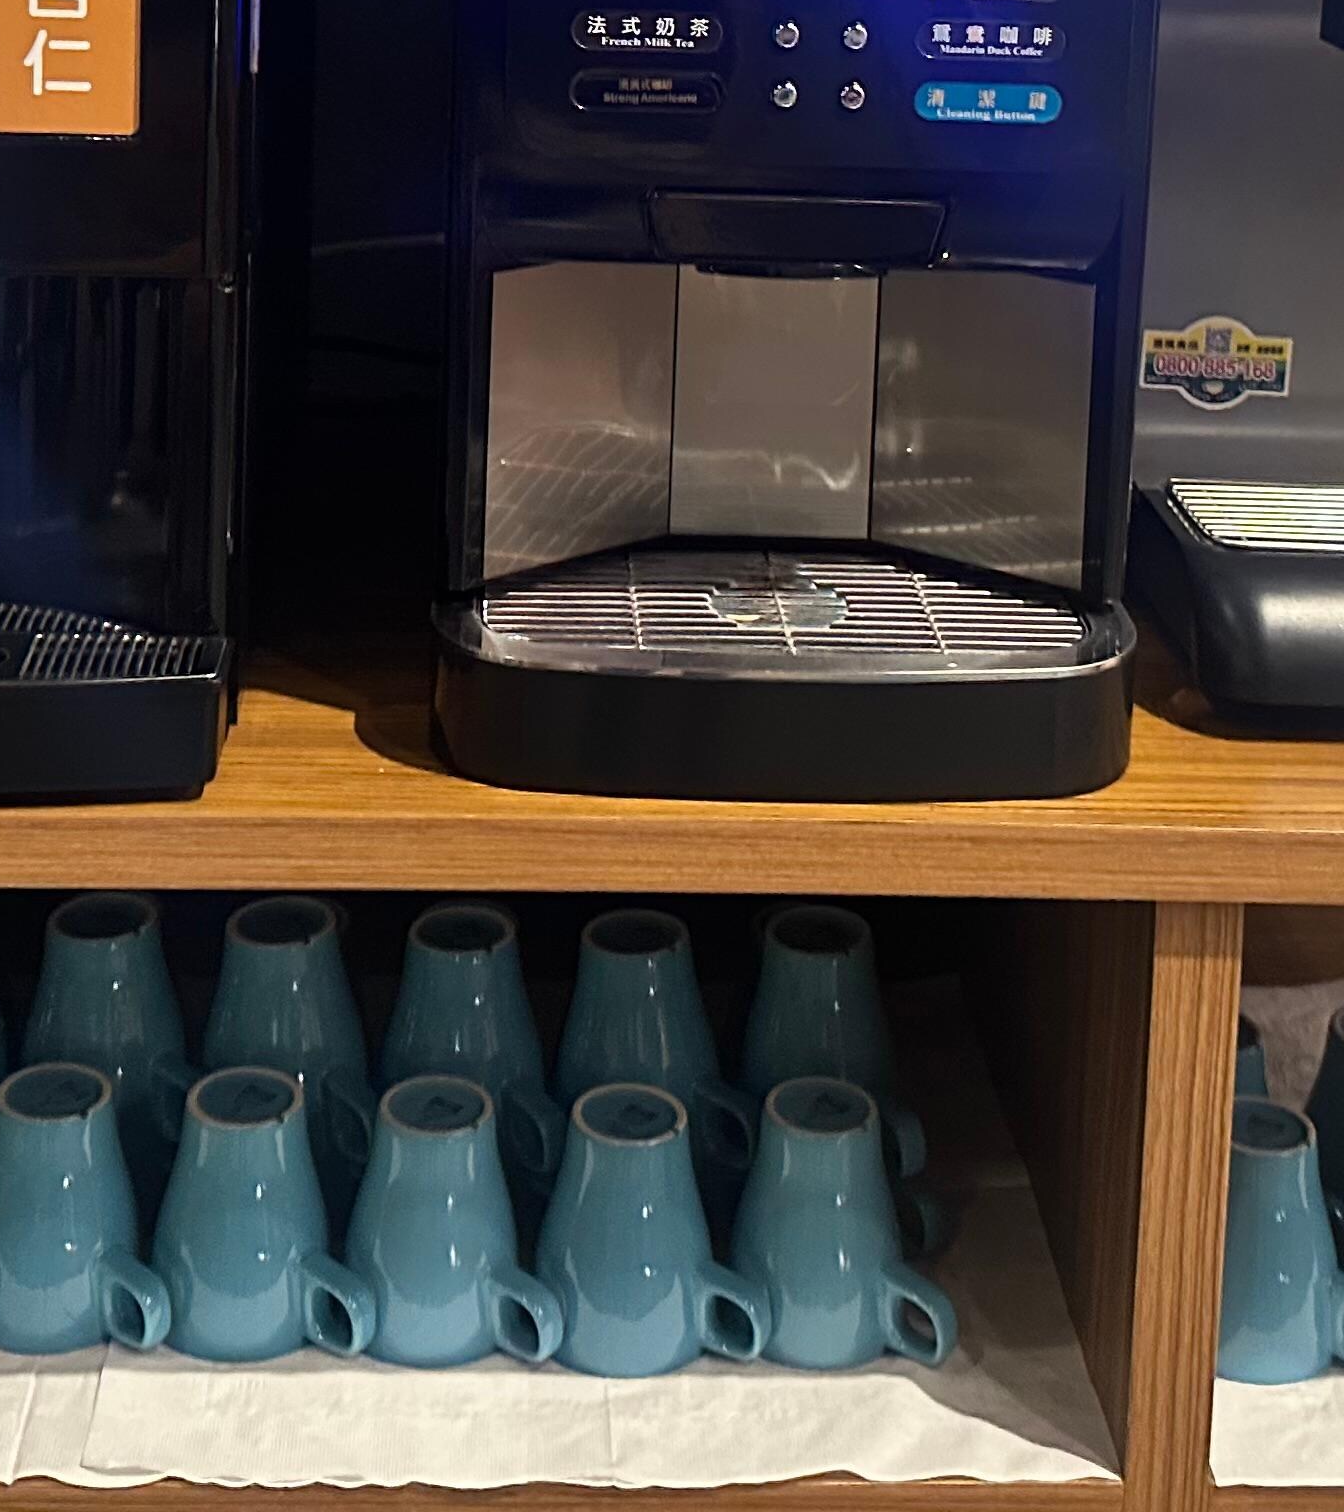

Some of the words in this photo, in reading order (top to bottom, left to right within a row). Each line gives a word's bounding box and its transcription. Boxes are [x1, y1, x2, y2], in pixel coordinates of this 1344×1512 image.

[587, 15, 710, 37] 法式奶茶
[601, 36, 641, 47] French
[643, 37, 672, 48] Milk
[674, 38, 695, 49] Tea
[987, 46, 1012, 56] Duck
[1012, 46, 1044, 57] Coffee
[936, 106, 991, 121] Cleaning
[994, 109, 1036, 122] Button
